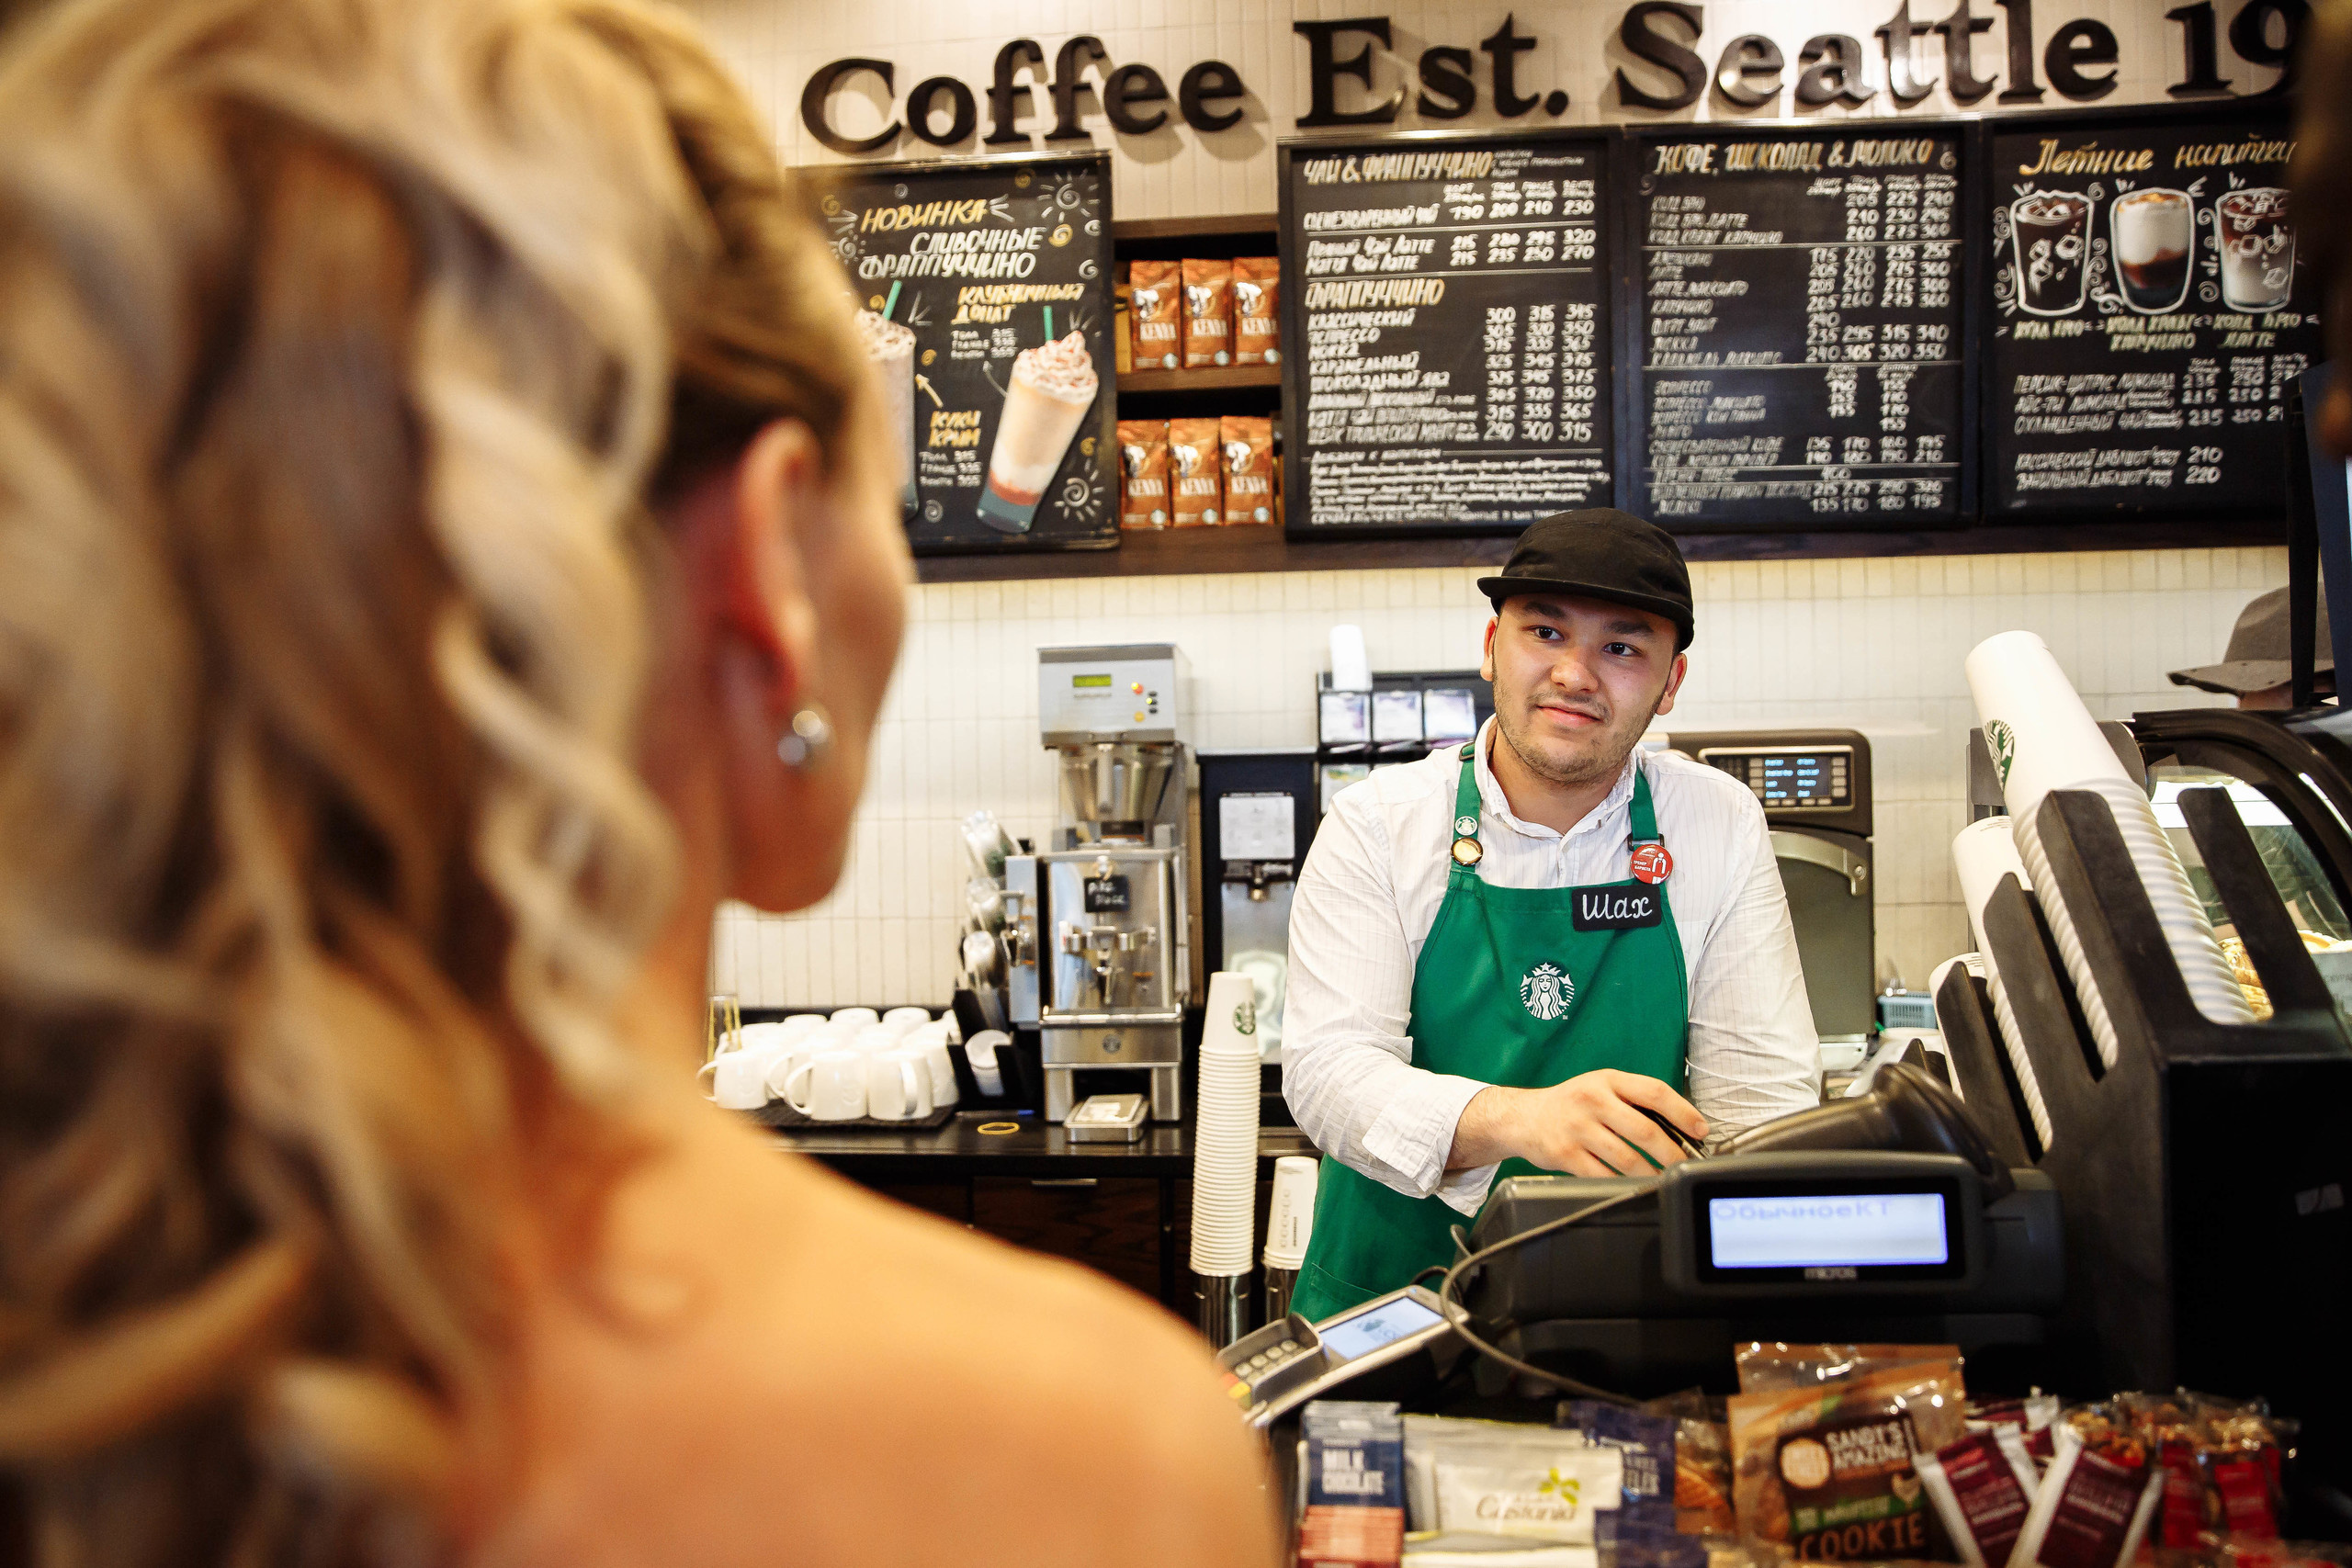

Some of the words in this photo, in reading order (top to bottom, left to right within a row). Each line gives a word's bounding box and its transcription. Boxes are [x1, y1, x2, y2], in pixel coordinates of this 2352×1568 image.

[800, 35, 1246, 152] Coffee
[1292, 11, 1569, 128] Est.
[1614, 0, 2120, 111] Seattle
[1826, 141, 1845, 168] &
[1842, 139, 1935, 169] МОЛОКО
[2019, 139, 2154, 175] Летние
[1303, 154, 1342, 185] ЧАЙ
[1341, 155, 1362, 183] &
[1522, 200, 1554, 216] 210
[1562, 199, 1595, 216] 230
[1845, 192, 1879, 208] 205
[860, 198, 989, 233] НОВИНКА
[1847, 208, 1880, 224] 210
[1885, 207, 1917, 224] 230
[910, 227, 1047, 255] СЛИВОЧНЫЕ
[1563, 228, 1597, 245] 320
[1845, 246, 1876, 262] 220
[1885, 243, 1918, 261] 235
[858, 252, 1036, 279] ФРАППУЧЧИНО
[1843, 260, 1876, 277] 260
[1841, 276, 1875, 292] 260
[1840, 291, 1874, 309] 260
[1485, 306, 1516, 324] 300
[1561, 319, 1595, 336] 350
[1805, 326, 1841, 345] 235
[1881, 323, 1912, 342] 315
[1525, 335, 1555, 352] 335
[1805, 344, 1841, 362] 240
[1840, 343, 1875, 361] 305
[1878, 343, 1911, 361] 320
[1913, 343, 1948, 360] 350
[1561, 368, 1598, 385] 375
[1523, 386, 1555, 401] 320
[1562, 385, 1597, 401] 350
[2228, 387, 2264, 403] 250
[1485, 404, 1517, 422] 315
[1522, 402, 1554, 420] 335
[1559, 401, 1595, 421] 365
[1483, 421, 1515, 442] 290
[1521, 421, 1555, 442] 300
[1558, 421, 1594, 443] 315
[2187, 446, 2223, 464] 210
[1821, 467, 1851, 480] 400
[2185, 466, 2222, 485] 220
[1321, 1449, 1364, 1472] MILK
[1799, 1512, 1926, 1562] COOKIE
